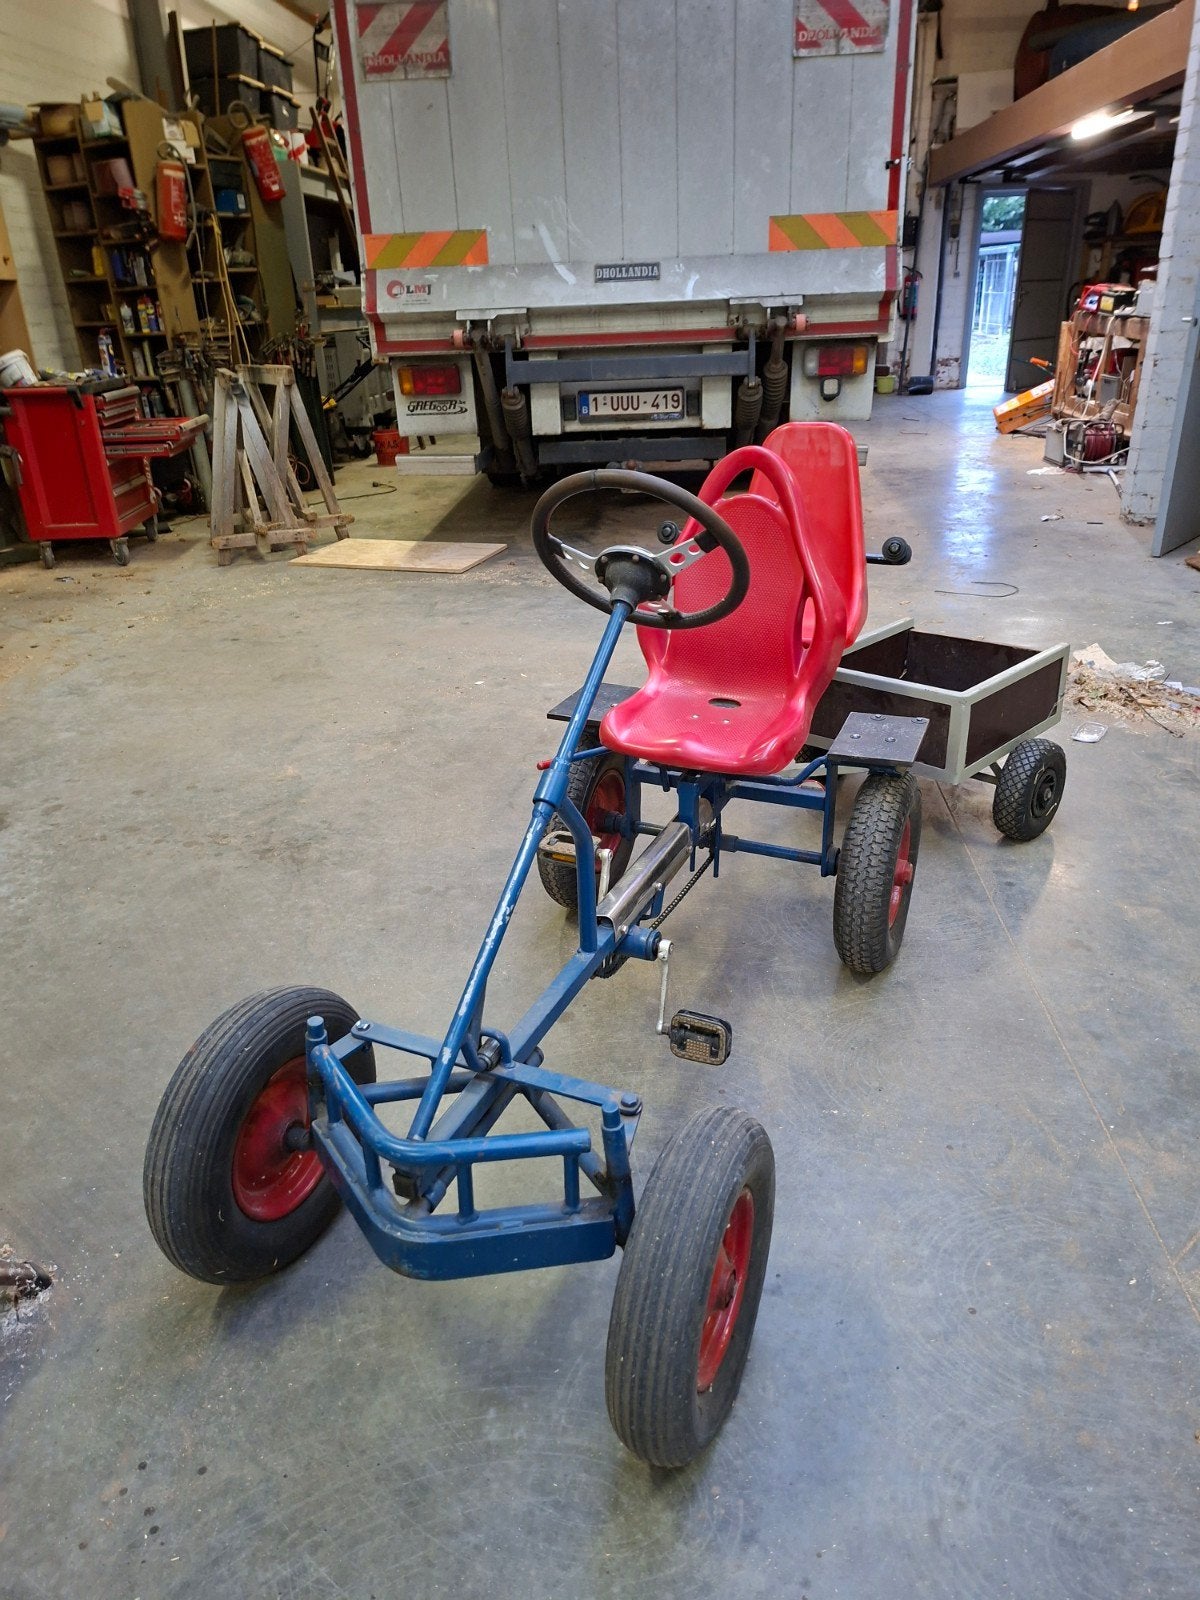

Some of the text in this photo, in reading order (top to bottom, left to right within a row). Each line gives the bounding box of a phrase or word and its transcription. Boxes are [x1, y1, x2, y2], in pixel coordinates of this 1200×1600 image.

[596, 265, 660, 279] DHOLLANDIA
[405, 284, 432, 296] LMJ
[582, 405, 589, 414] B
